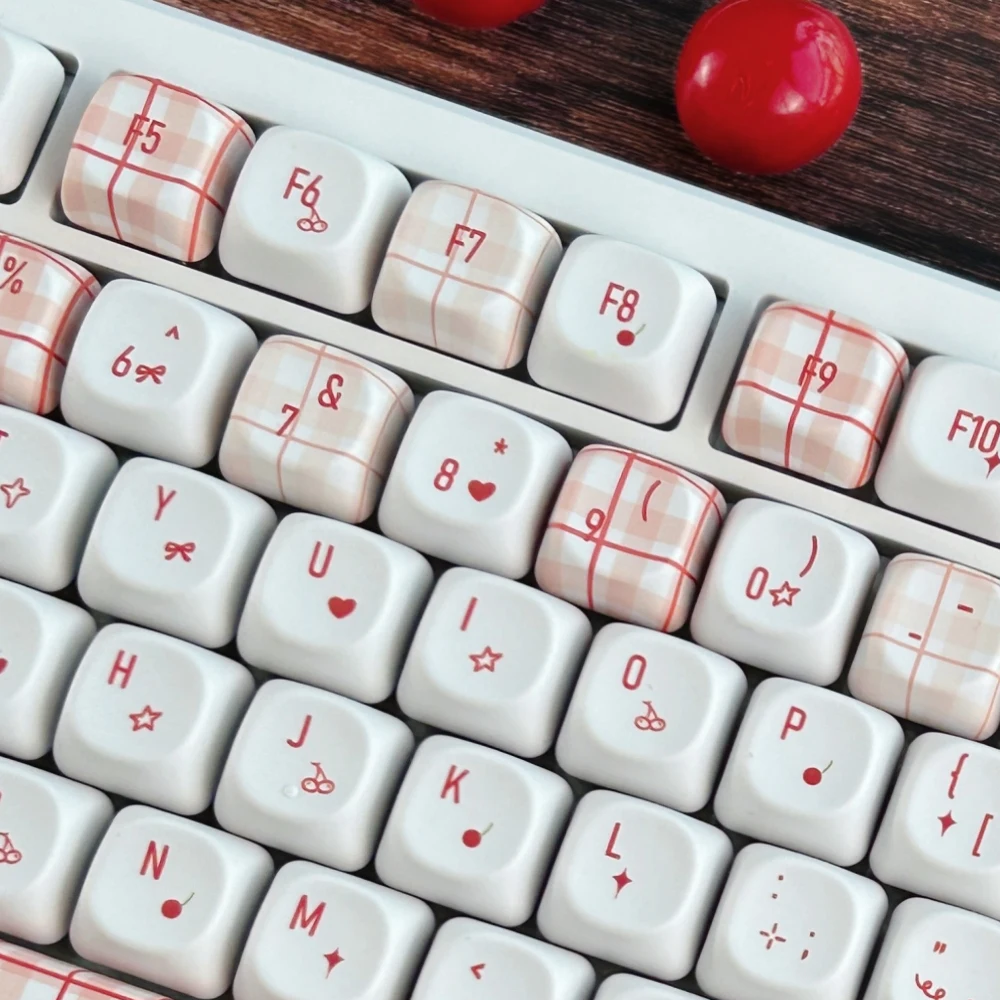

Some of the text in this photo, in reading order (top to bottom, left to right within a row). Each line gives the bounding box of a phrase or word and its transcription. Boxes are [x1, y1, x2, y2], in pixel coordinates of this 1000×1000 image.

[123, 114, 166, 154] F5
[283, 167, 323, 207] F6
[445, 223, 486, 263] F7
[599, 282, 640, 322] F8
[111, 345, 135, 379] 6
[799, 355, 837, 393] F9
[318, 374, 344, 410] &
[276, 404, 300, 437] 7
[433, 458, 460, 492] 8
[155, 485, 177, 521] Y
[642, 480, 662, 522] (
[583, 508, 606, 542] 9
[308, 541, 335, 578] U
[800, 536, 818, 578] )
[107, 649, 138, 689] H
[286, 714, 313, 748] J
[780, 706, 807, 740] P
[440, 764, 470, 804] K
[140, 840, 170, 880] N
[604, 822, 621, 860] L
[289, 894, 326, 936] M
